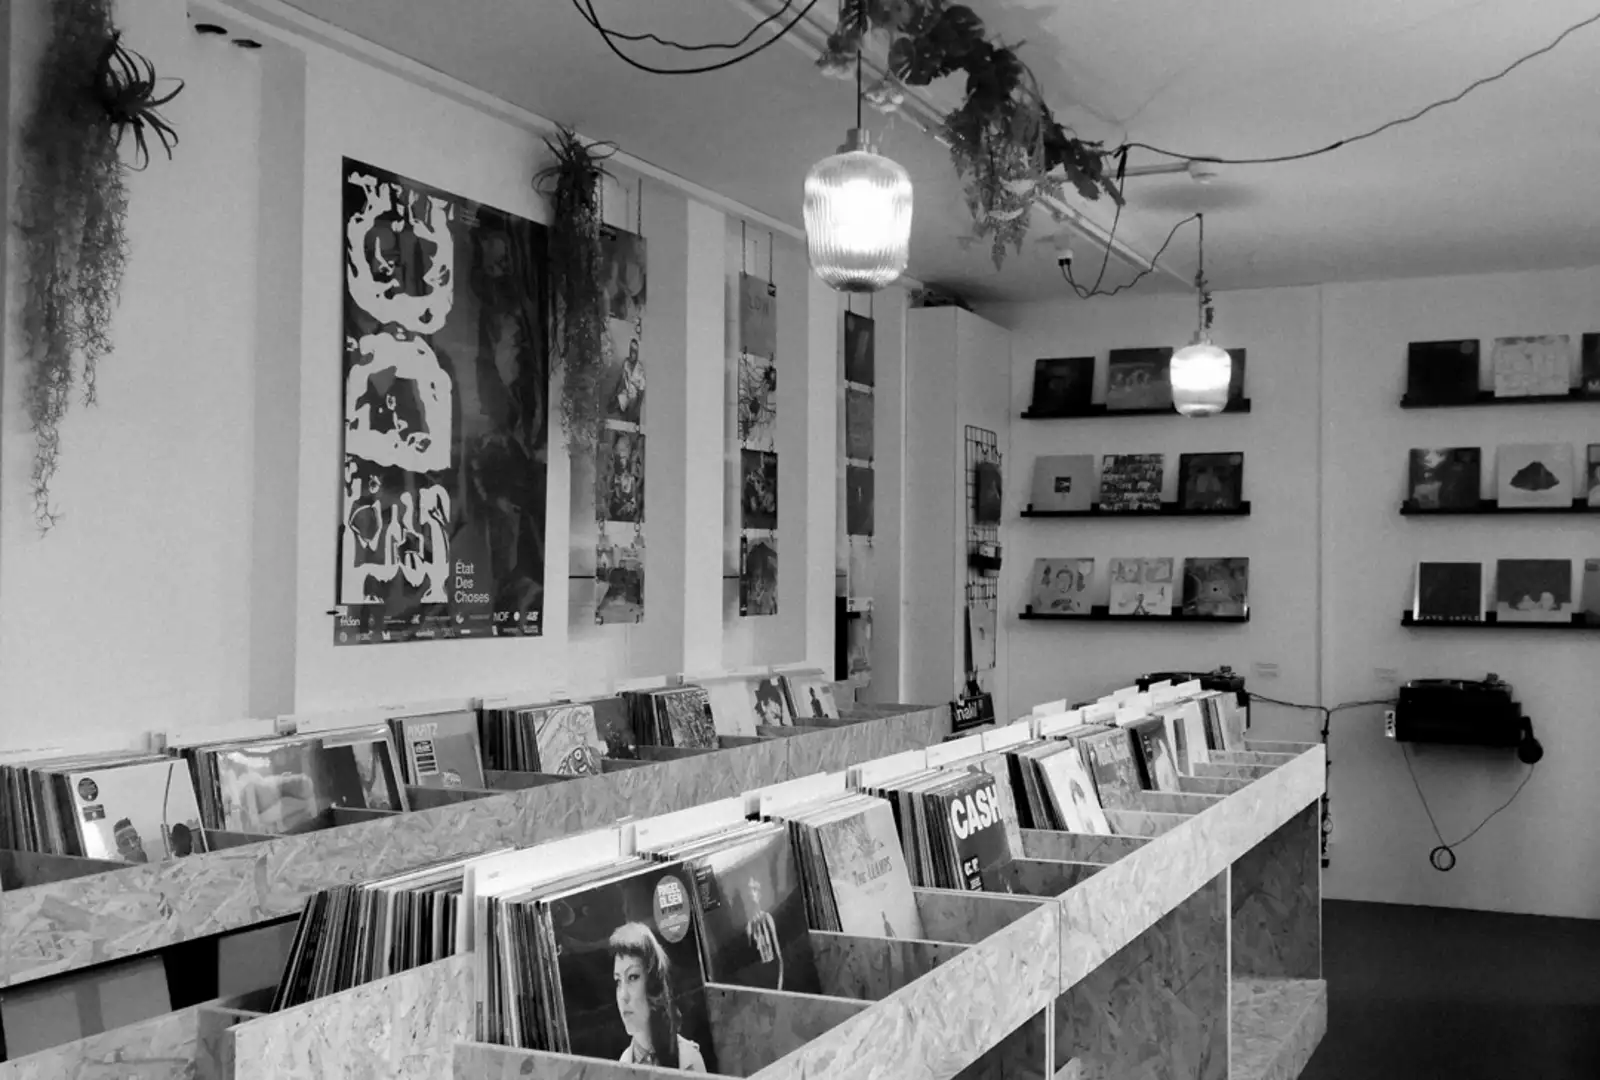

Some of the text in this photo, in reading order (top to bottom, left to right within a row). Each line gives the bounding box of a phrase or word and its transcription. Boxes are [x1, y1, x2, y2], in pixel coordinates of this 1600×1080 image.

[455, 559, 475, 575] État
[455, 576, 474, 590] Des
[454, 591, 490, 604] Choses
[951, 784, 1003, 839] CASH
